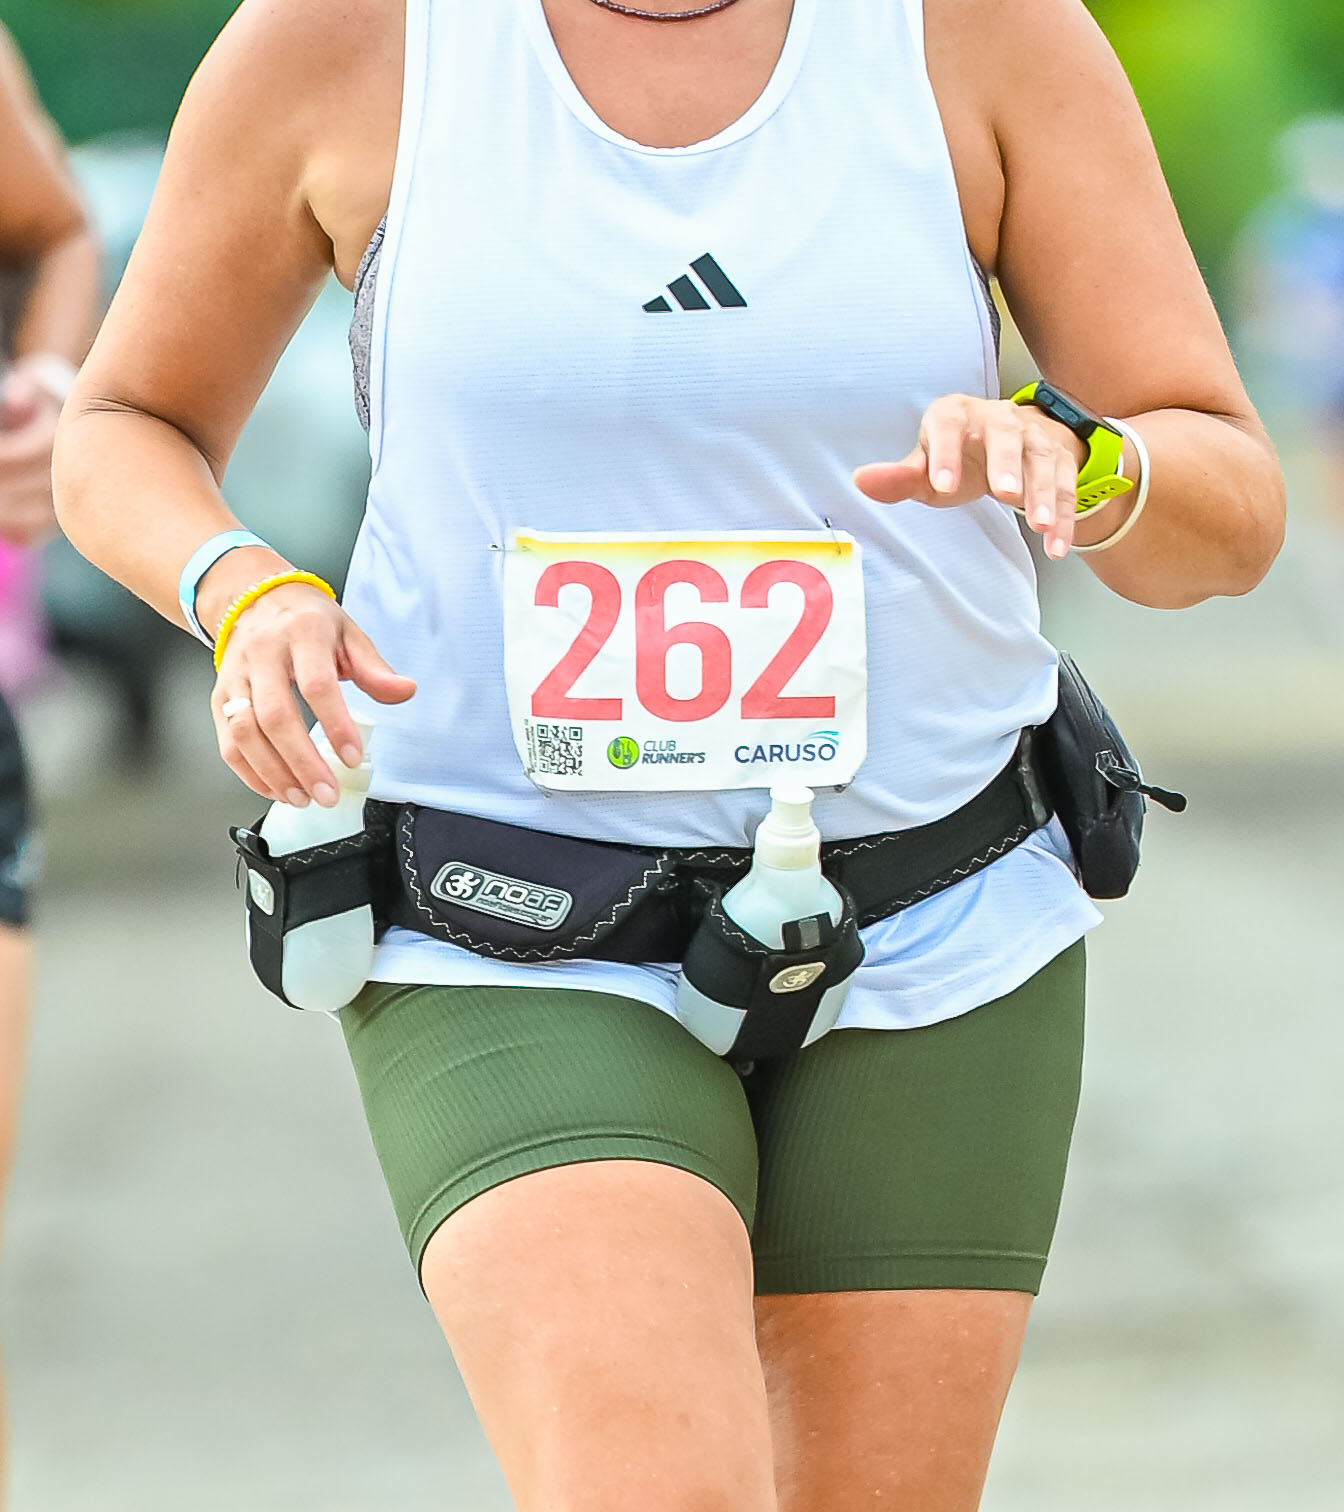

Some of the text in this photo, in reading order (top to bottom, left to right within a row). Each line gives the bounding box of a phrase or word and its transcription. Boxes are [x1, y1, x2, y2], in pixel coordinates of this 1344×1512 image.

[531, 560, 836, 721] 262
[643, 740, 677, 752] CLUB
[734, 743, 837, 764] CARUSO
